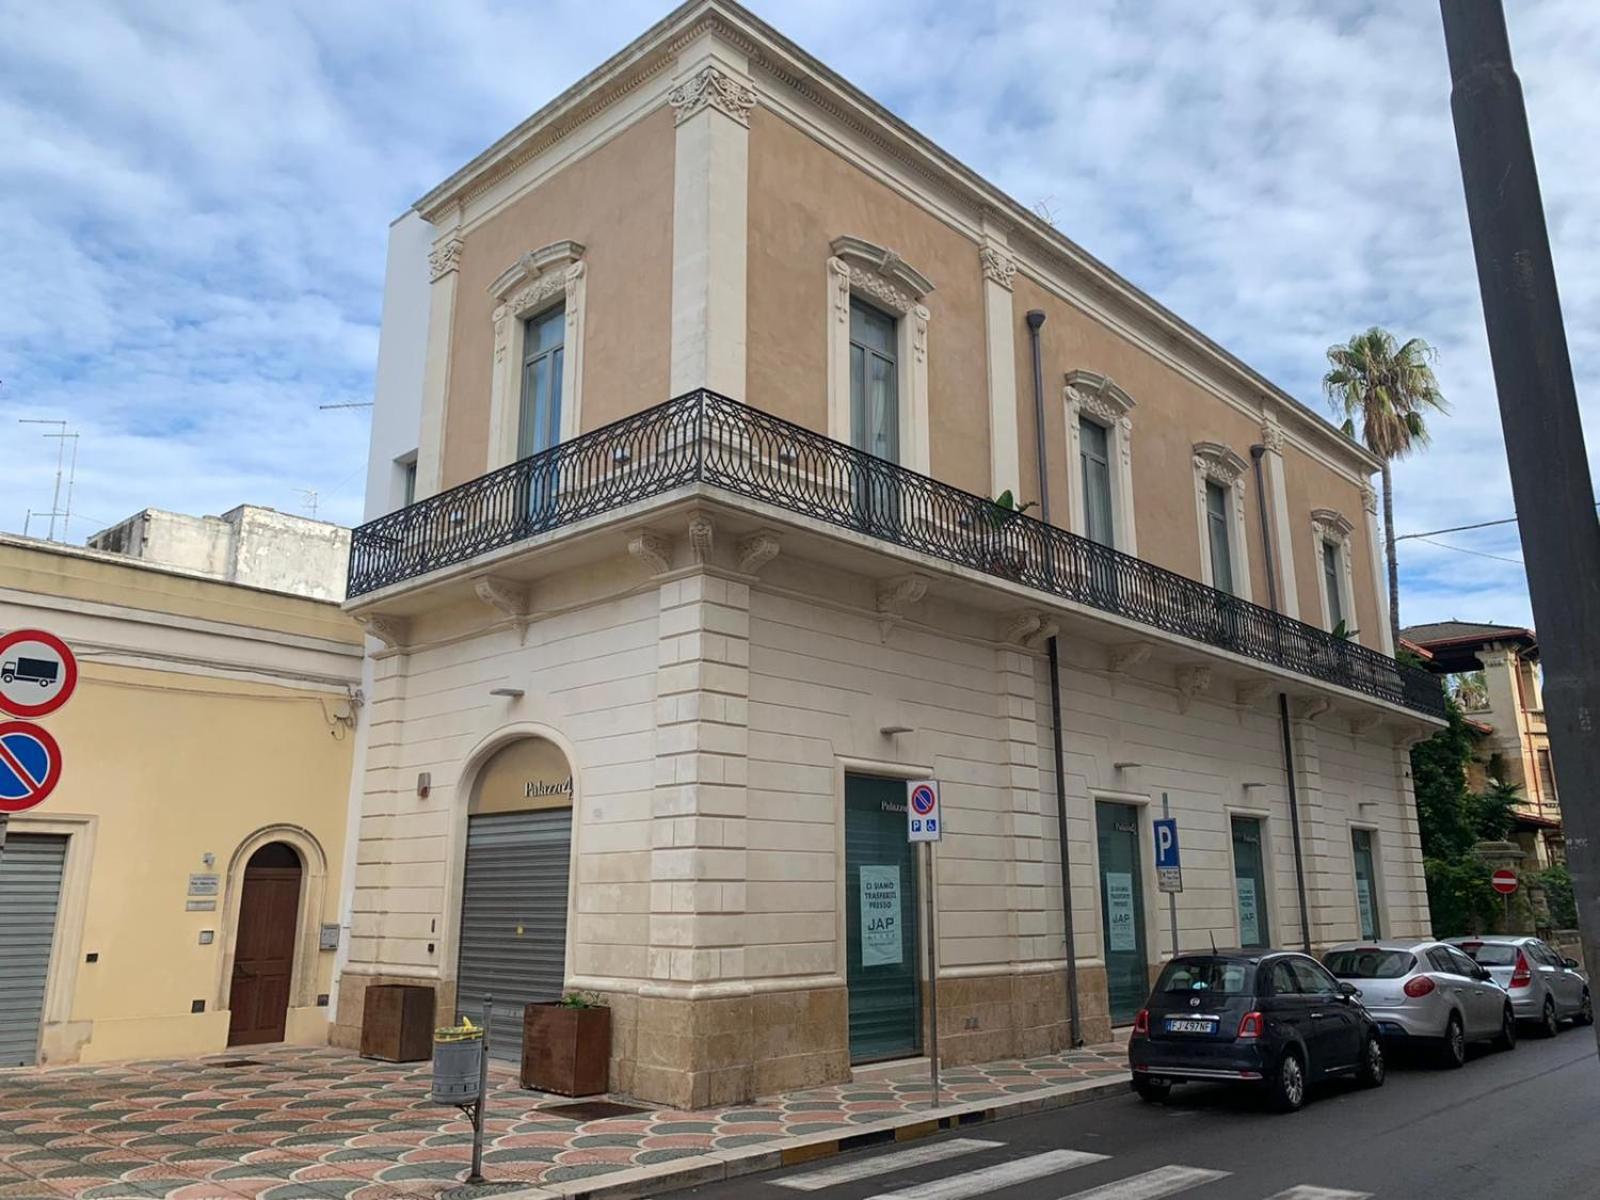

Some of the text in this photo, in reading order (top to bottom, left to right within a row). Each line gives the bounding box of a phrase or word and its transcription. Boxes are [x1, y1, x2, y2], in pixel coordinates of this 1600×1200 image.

[914, 821, 920, 832] P
[1158, 826, 1172, 861] P
[874, 882, 894, 890] SIAMO
[869, 901, 892, 909] PRESSO
[867, 917, 895, 931] JAP
